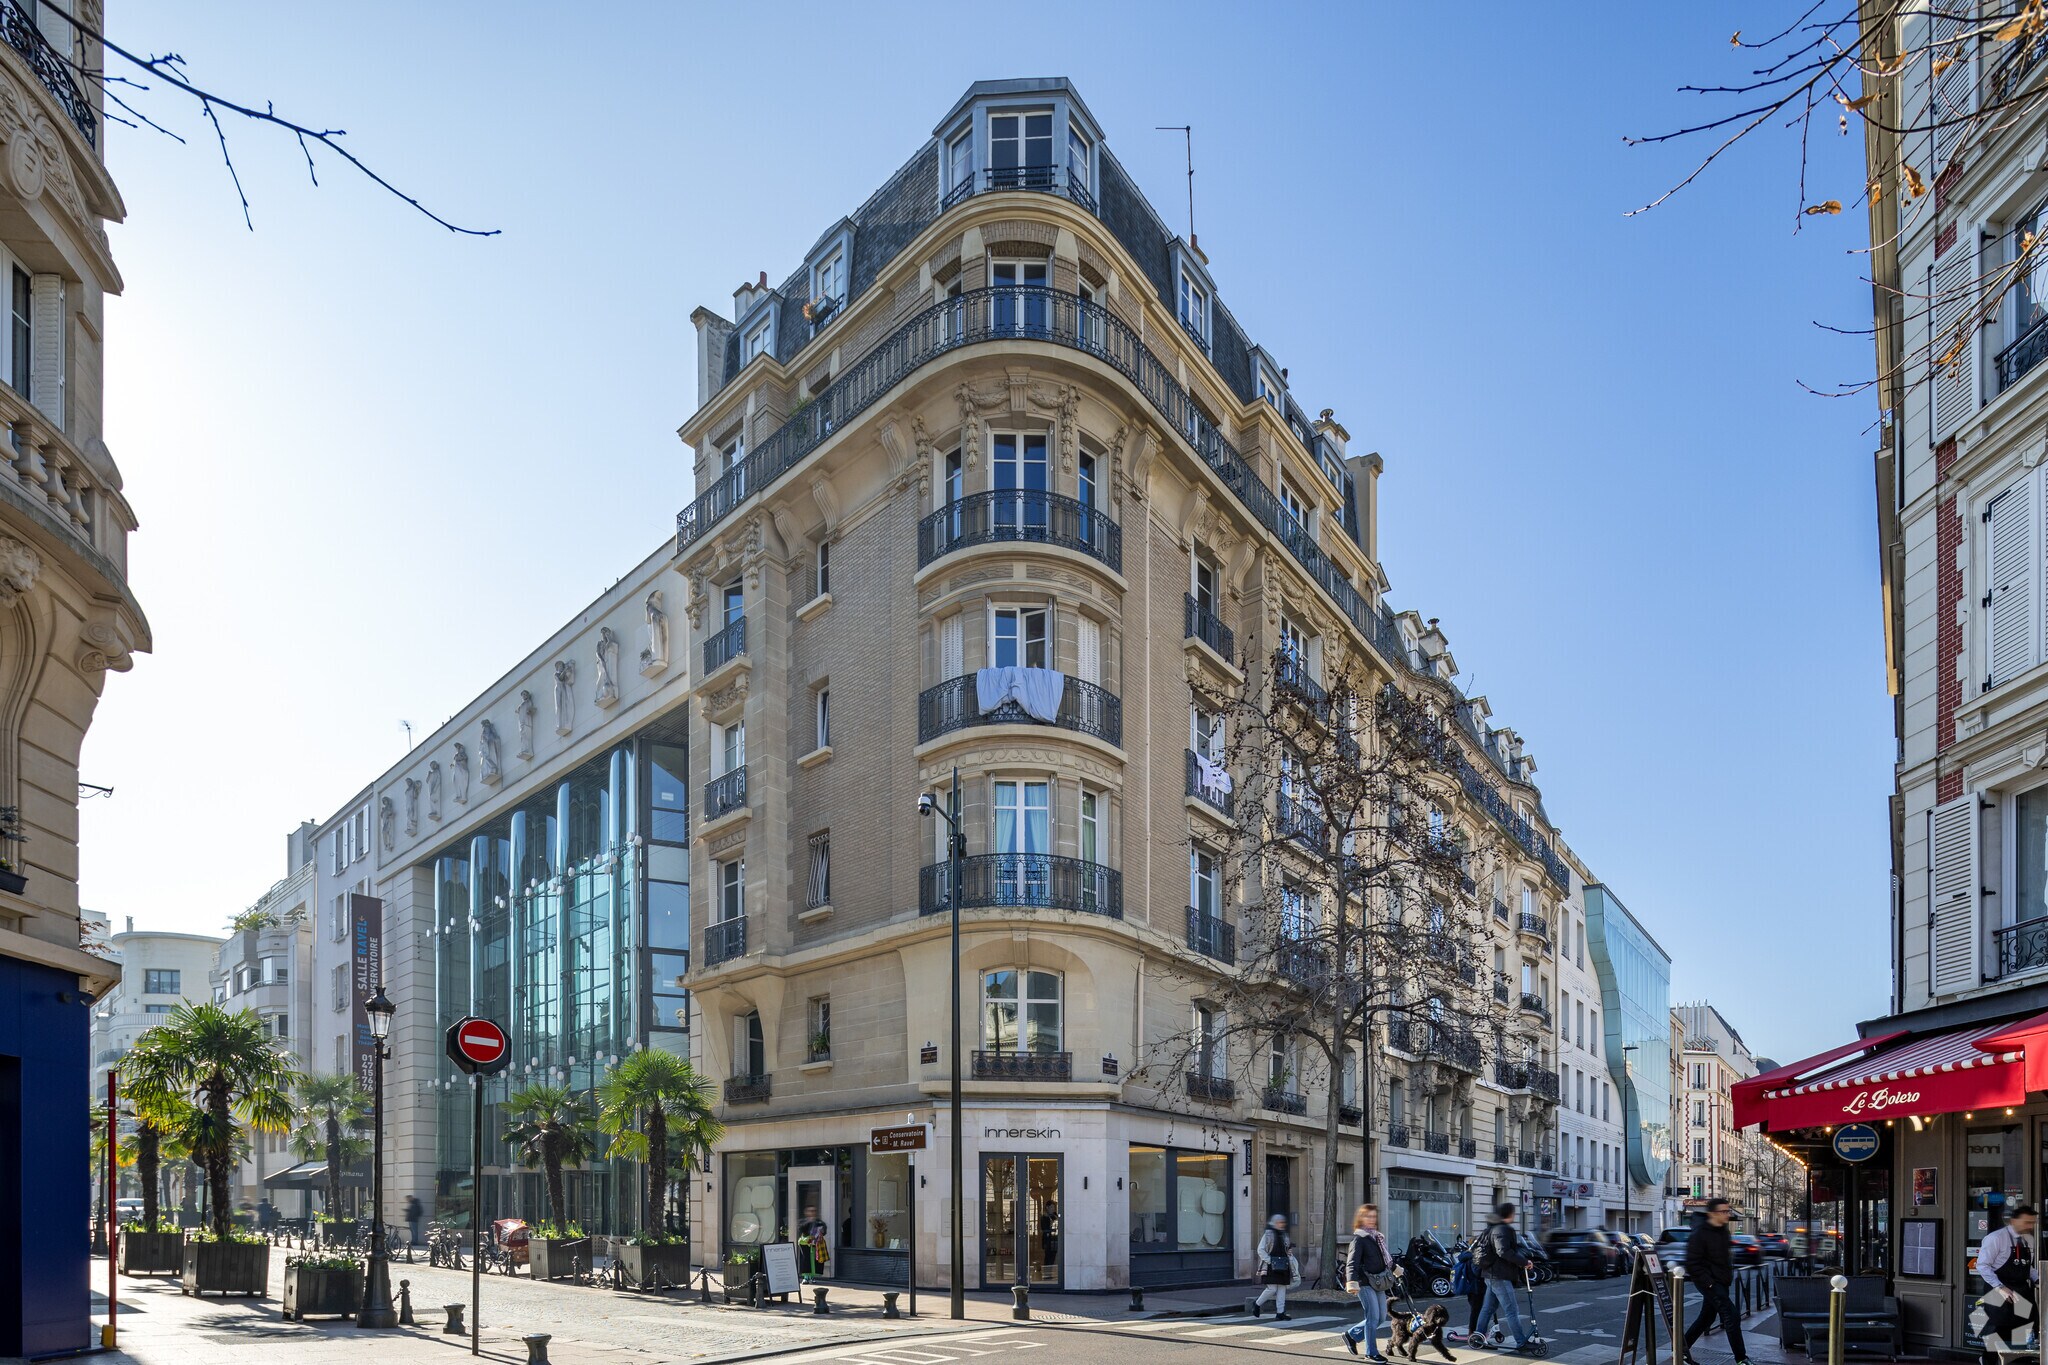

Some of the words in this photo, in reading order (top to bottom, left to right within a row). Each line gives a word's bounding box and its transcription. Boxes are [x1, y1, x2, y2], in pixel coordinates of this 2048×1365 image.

[357, 920, 368, 955] RAVEL
[370, 937, 378, 997] NSERVATOIRE
[357, 957, 368, 990] SALLE
[361, 1061, 374, 1069] 47
[362, 1069, 374, 1077] 15
[361, 1076, 374, 1084] 76
[361, 1083, 374, 1091] 76
[1842, 1091, 1868, 1115] Le
[1867, 1087, 1920, 1110] Bolero
[889, 1130, 924, 1138] Conservatoire
[984, 1126, 1061, 1139] innerskin
[900, 1139, 915, 1147] Ravel
